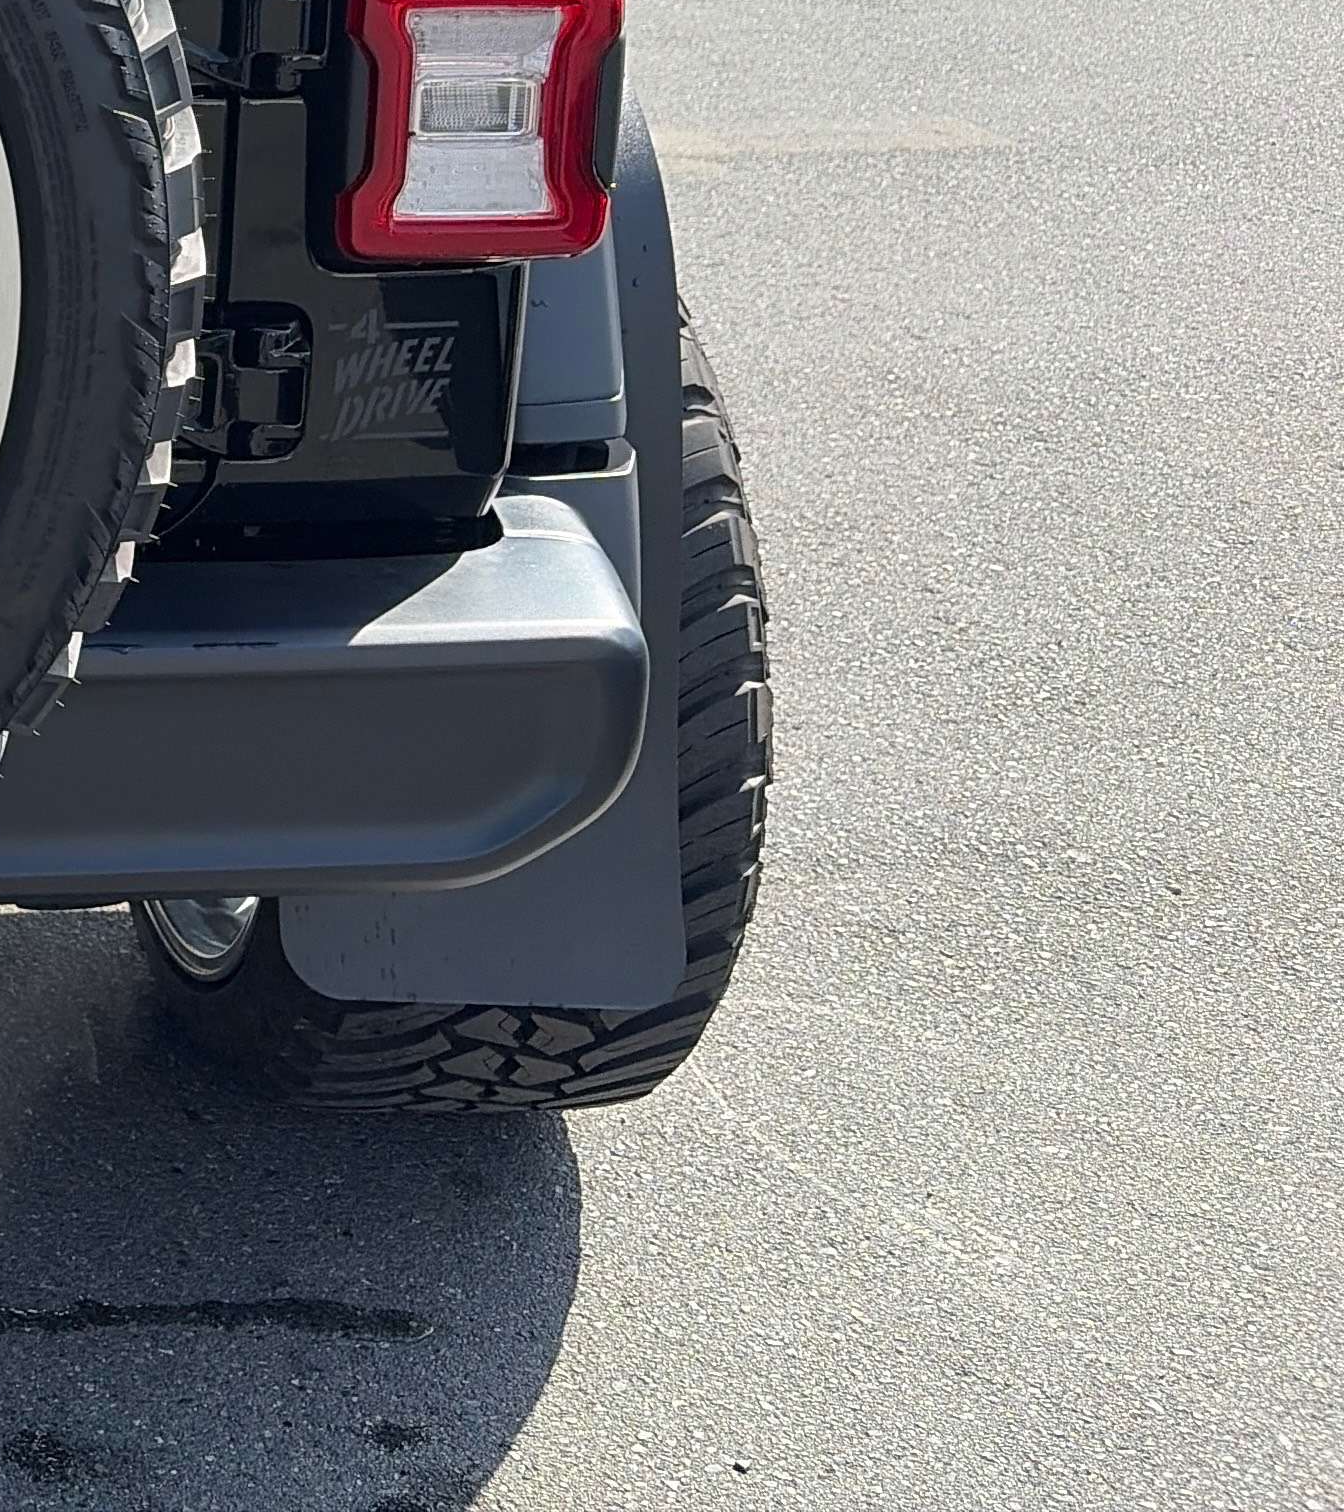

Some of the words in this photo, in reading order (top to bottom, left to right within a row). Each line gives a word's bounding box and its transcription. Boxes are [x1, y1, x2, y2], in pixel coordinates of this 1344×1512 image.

[350, 308, 382, 345] 4
[334, 336, 455, 394] WHEEL
[331, 378, 451, 441] DRIVE
